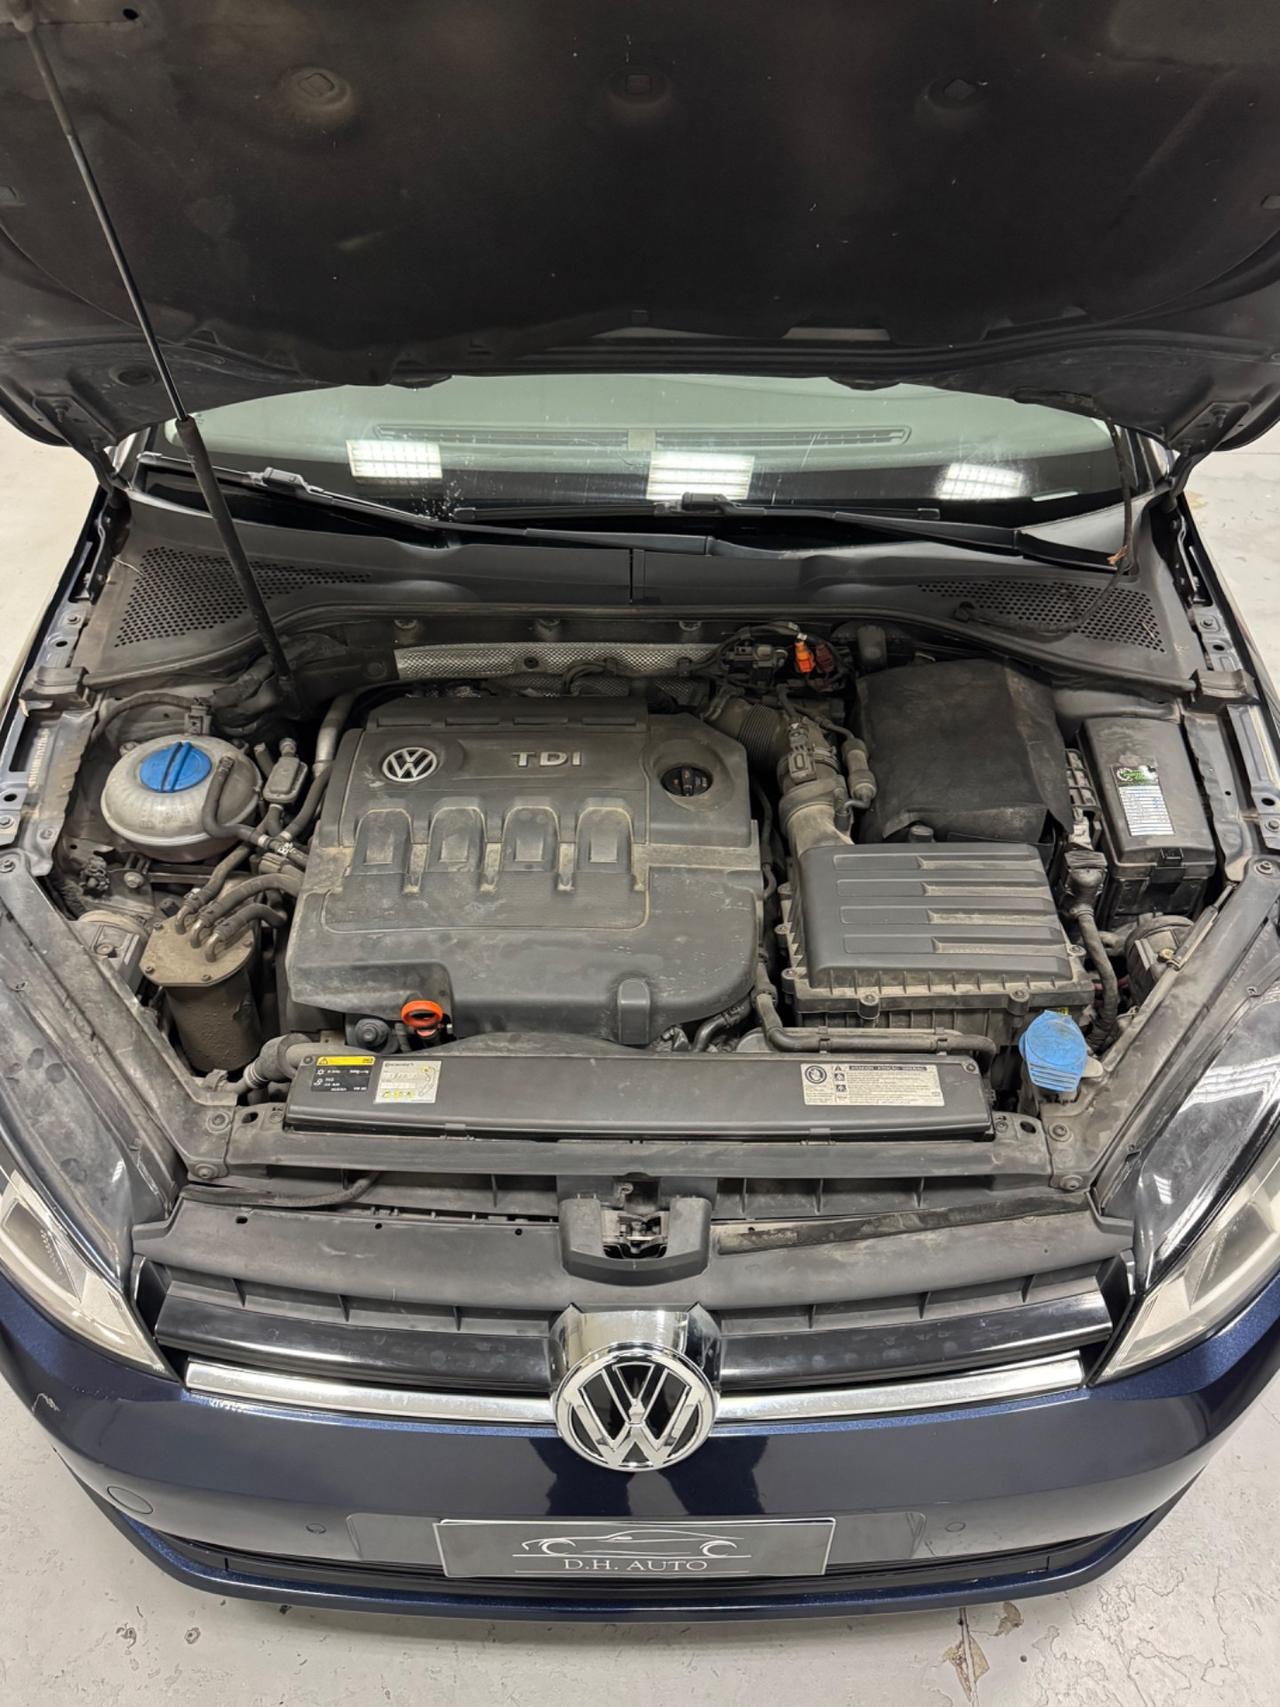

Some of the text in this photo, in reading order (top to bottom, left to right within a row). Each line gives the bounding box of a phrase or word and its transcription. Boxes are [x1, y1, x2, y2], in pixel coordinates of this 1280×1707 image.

[383, 747, 437, 782] VW
[512, 751, 581, 766] TDI
[557, 1345, 716, 1471] VW
[564, 1559, 708, 1571] D.H. AUTO
